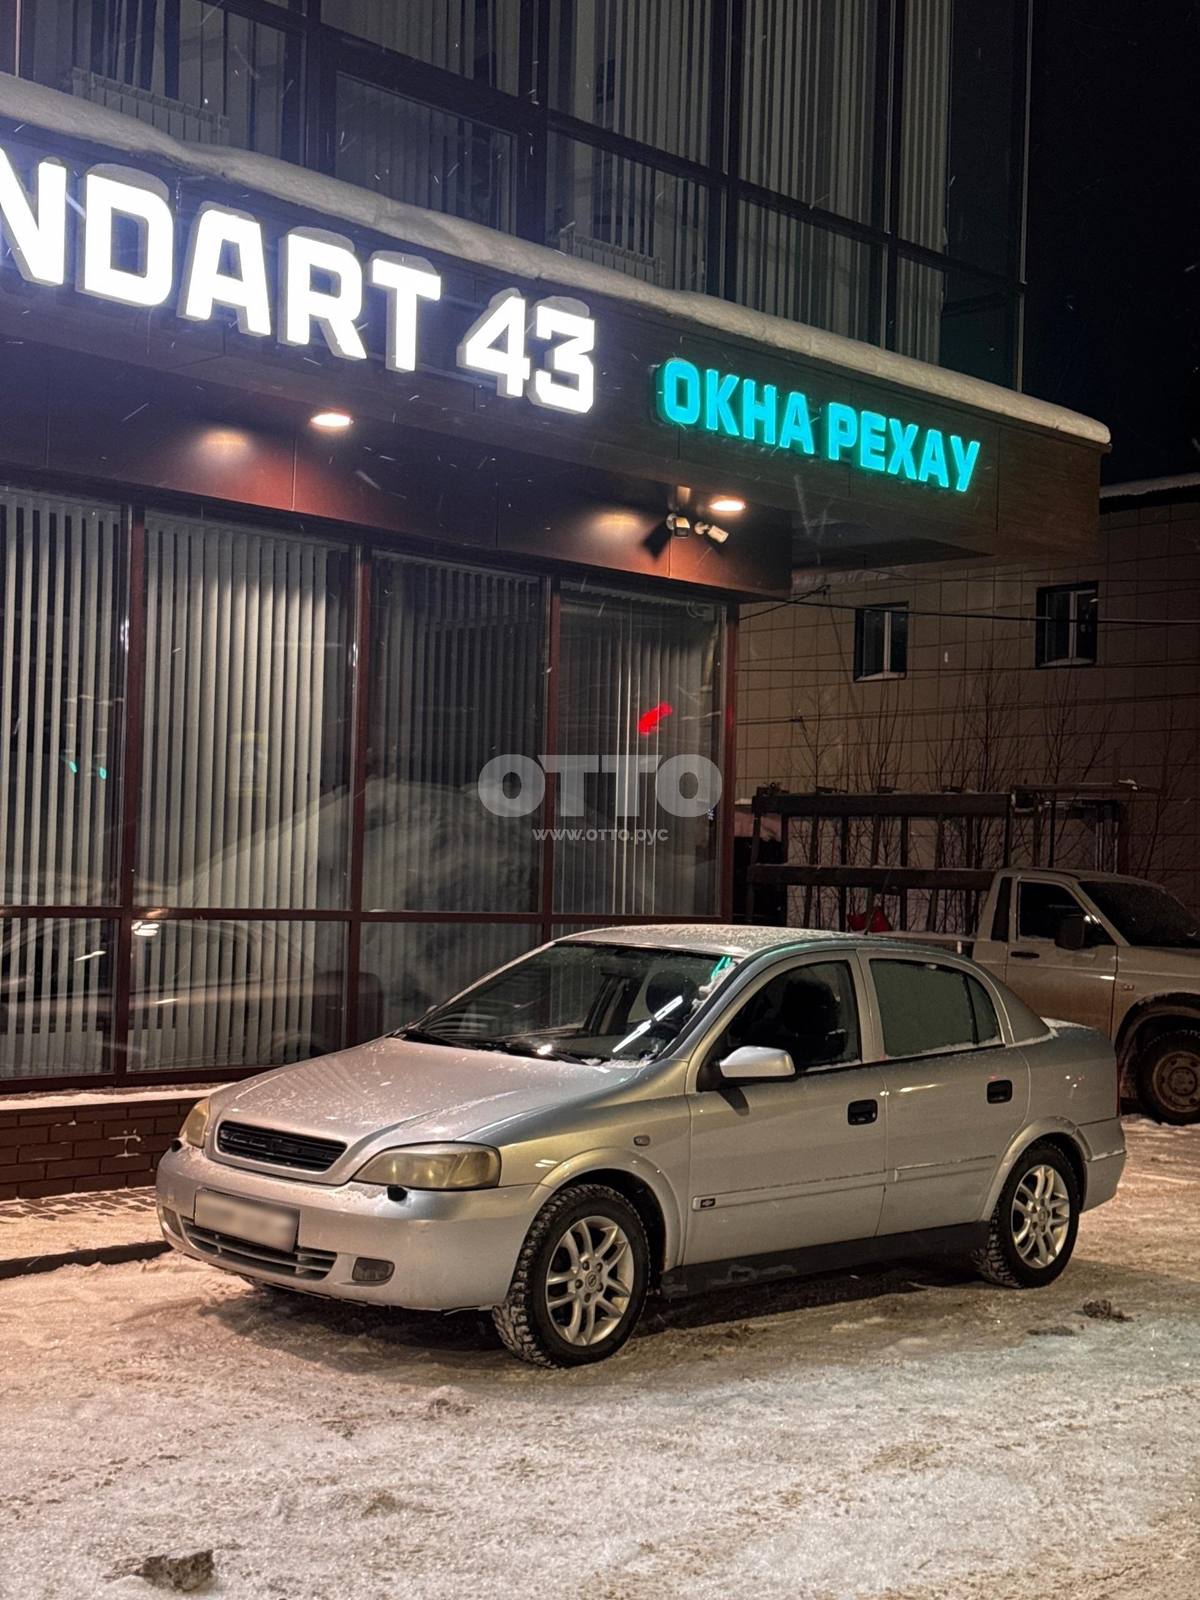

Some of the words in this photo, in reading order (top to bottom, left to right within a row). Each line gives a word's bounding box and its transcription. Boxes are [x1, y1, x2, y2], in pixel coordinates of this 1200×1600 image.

[464, 295, 596, 414] 43
[661, 358, 815, 455] ОКНА
[827, 401, 981, 492] РЕХАУ
